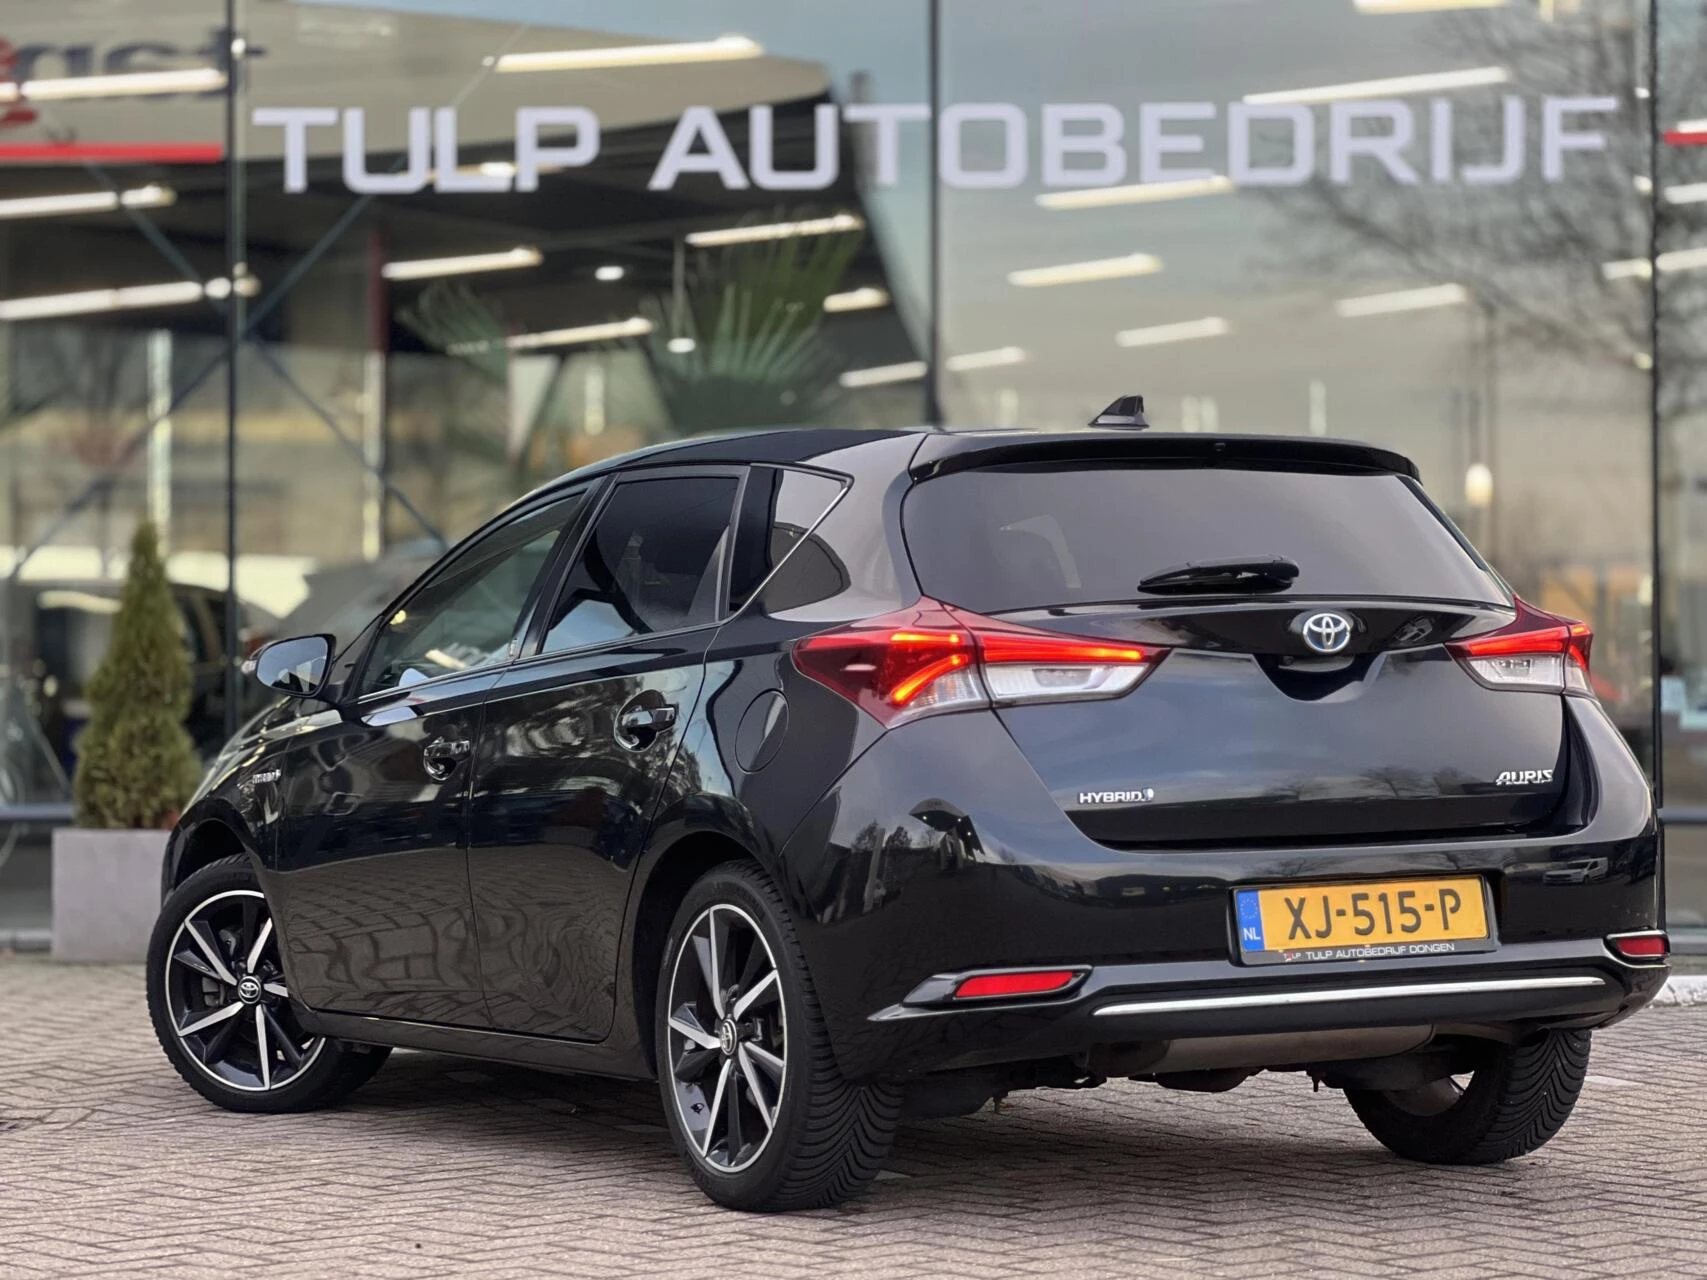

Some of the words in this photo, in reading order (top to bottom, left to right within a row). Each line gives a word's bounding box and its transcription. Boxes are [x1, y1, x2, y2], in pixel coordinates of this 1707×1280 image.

[252, 106, 601, 195] TULP
[648, 94, 1619, 192] AUTOBEDRIJF
[1495, 769, 1553, 786] AURIS
[1079, 790, 1144, 804] HYBRID
[1283, 888, 1461, 940] XJ-515-P
[1243, 927, 1261, 941] NL
[1305, 949, 1333, 961] TULP
[1335, 945, 1407, 959] AUTOBEDRIJF
[1409, 942, 1456, 954] DONGEN
